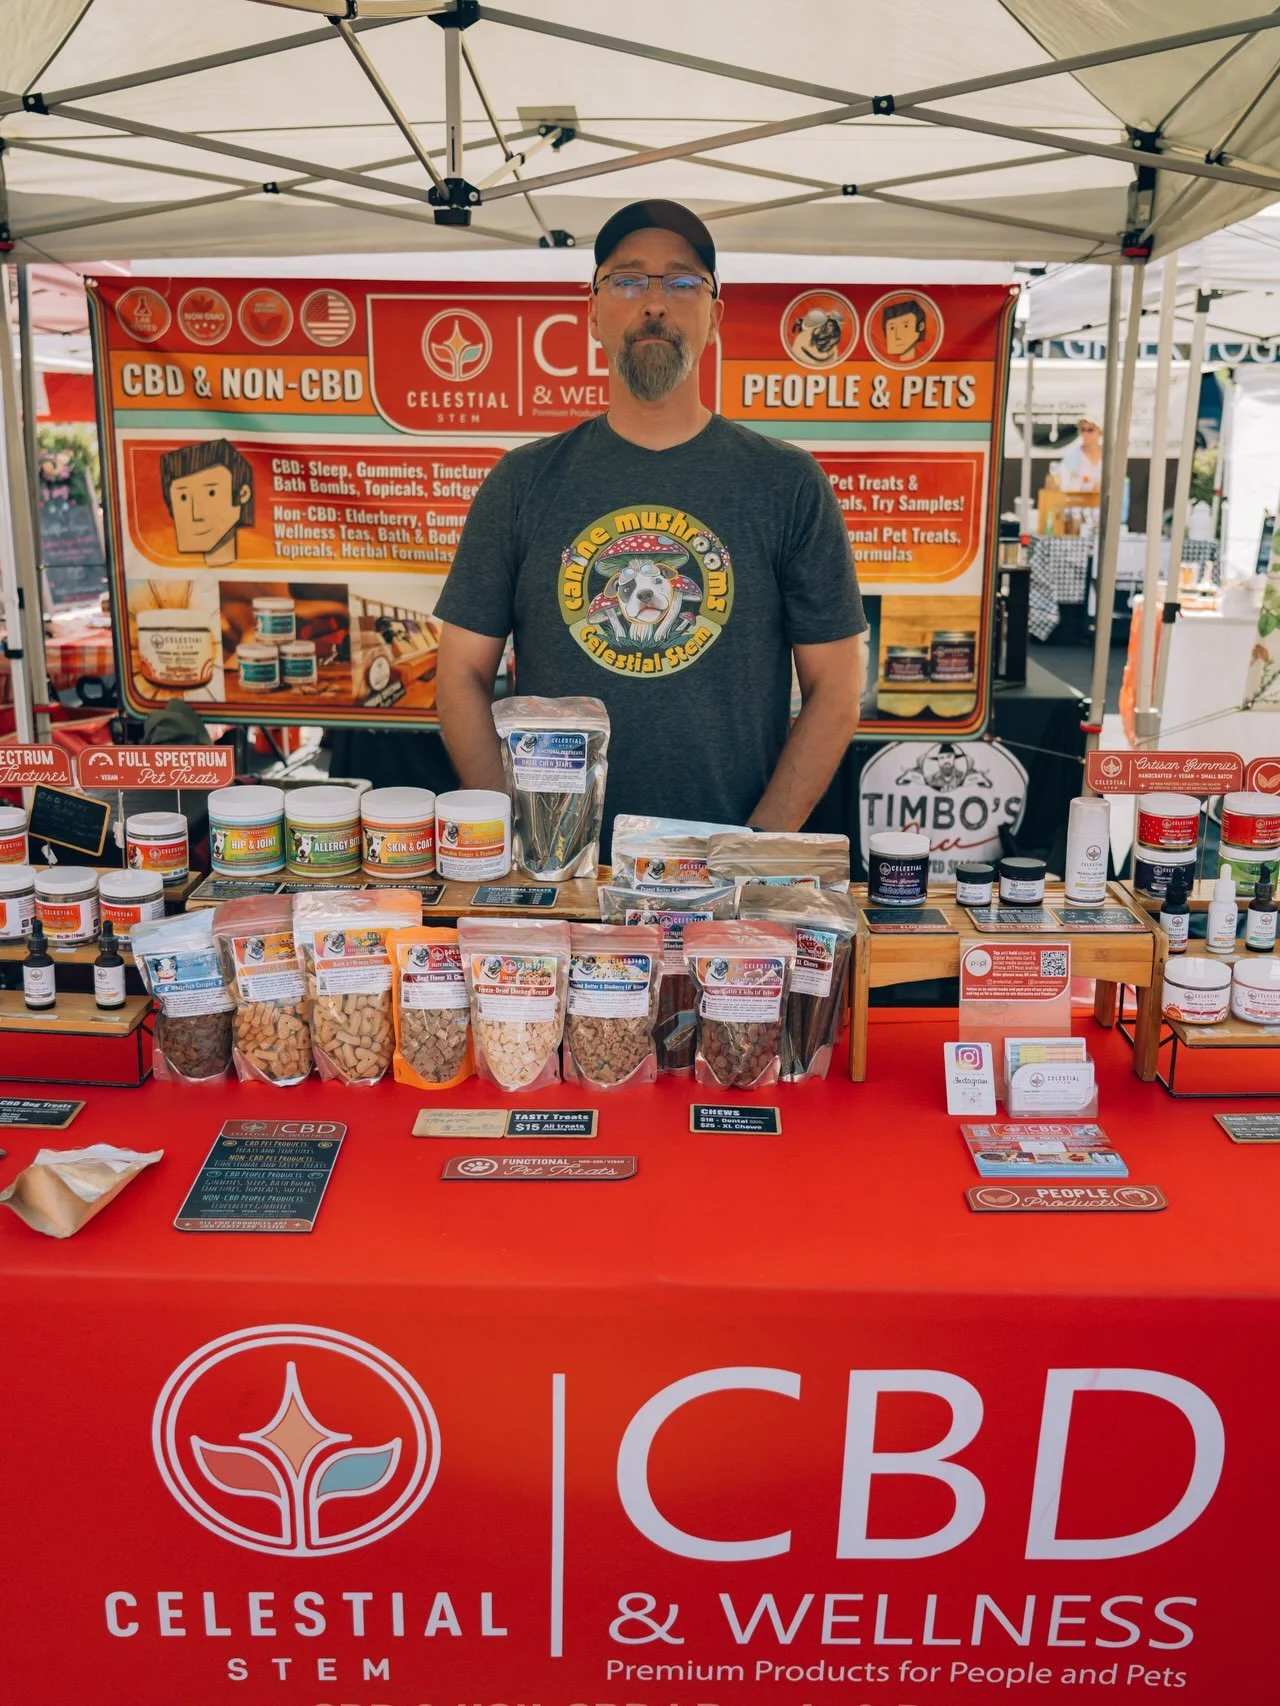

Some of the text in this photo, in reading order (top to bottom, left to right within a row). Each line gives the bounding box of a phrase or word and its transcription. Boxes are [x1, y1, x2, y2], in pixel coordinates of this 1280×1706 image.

[122, 362, 364, 402] CBD & NON-CBD
[406, 391, 510, 409] CELESTIAL
[532, 385, 553, 405] &
[742, 373, 977, 410] PEOPLE & PETS
[437, 413, 480, 424] STEM
[272, 458, 305, 476] CBD:
[308, 459, 353, 480] Sleep,
[356, 462, 428, 481] Gummies,
[273, 476, 481, 500] Bath Bombs, Topicals, Softge
[829, 474, 919, 492] Pet Treats &
[838, 495, 965, 514] als, Try Samples!
[273, 505, 341, 523] Non-CBD:
[345, 508, 422, 529] Elderberry,
[273, 524, 336, 540] Wellness
[339, 525, 375, 542] Teas,
[378, 527, 410, 544] Bath
[415, 529, 424, 544] &
[882, 527, 908, 544] Pet
[912, 527, 961, 545] Treats,
[274, 541, 455, 563] Topicals, Herbal Formulas
[853, 547, 913, 562] ormulas
[579, 625, 714, 673] Celestial Stem
[118, 751, 228, 768] FULL SPECTRUM
[1135, 757, 1239, 773] Artisan Gummies
[0, 764, 69, 783] Tinctures
[137, 768, 167, 785] Pet
[169, 765, 221, 786] Treats
[862, 793, 1022, 831] TIMBO'S
[162, 846, 186, 854] CELESTIAL
[231, 837, 277, 851] HIP & JOINT
[314, 840, 349, 853] ALLERGY
[386, 838, 433, 853] SKIN & COAT
[952, 1077, 989, 1087] Instagram
[700, 1108, 740, 1116] CHEWS
[281, 1123, 336, 1134] CBD
[516, 1123, 540, 1132] $15
[504, 1163, 618, 1177] Pet Treats
[1021, 1196, 1120, 1208] Products
[1036, 1188, 1111, 1199] PEOPLE
[616, 1366, 1226, 1562] CBD
[104, 1590, 509, 1638] CELESTIAL
[607, 1591, 1199, 1651] & WELLNESS
[226, 1657, 391, 1682] STEM
[606, 1658, 1188, 1689] Premium Products for People and Pets
